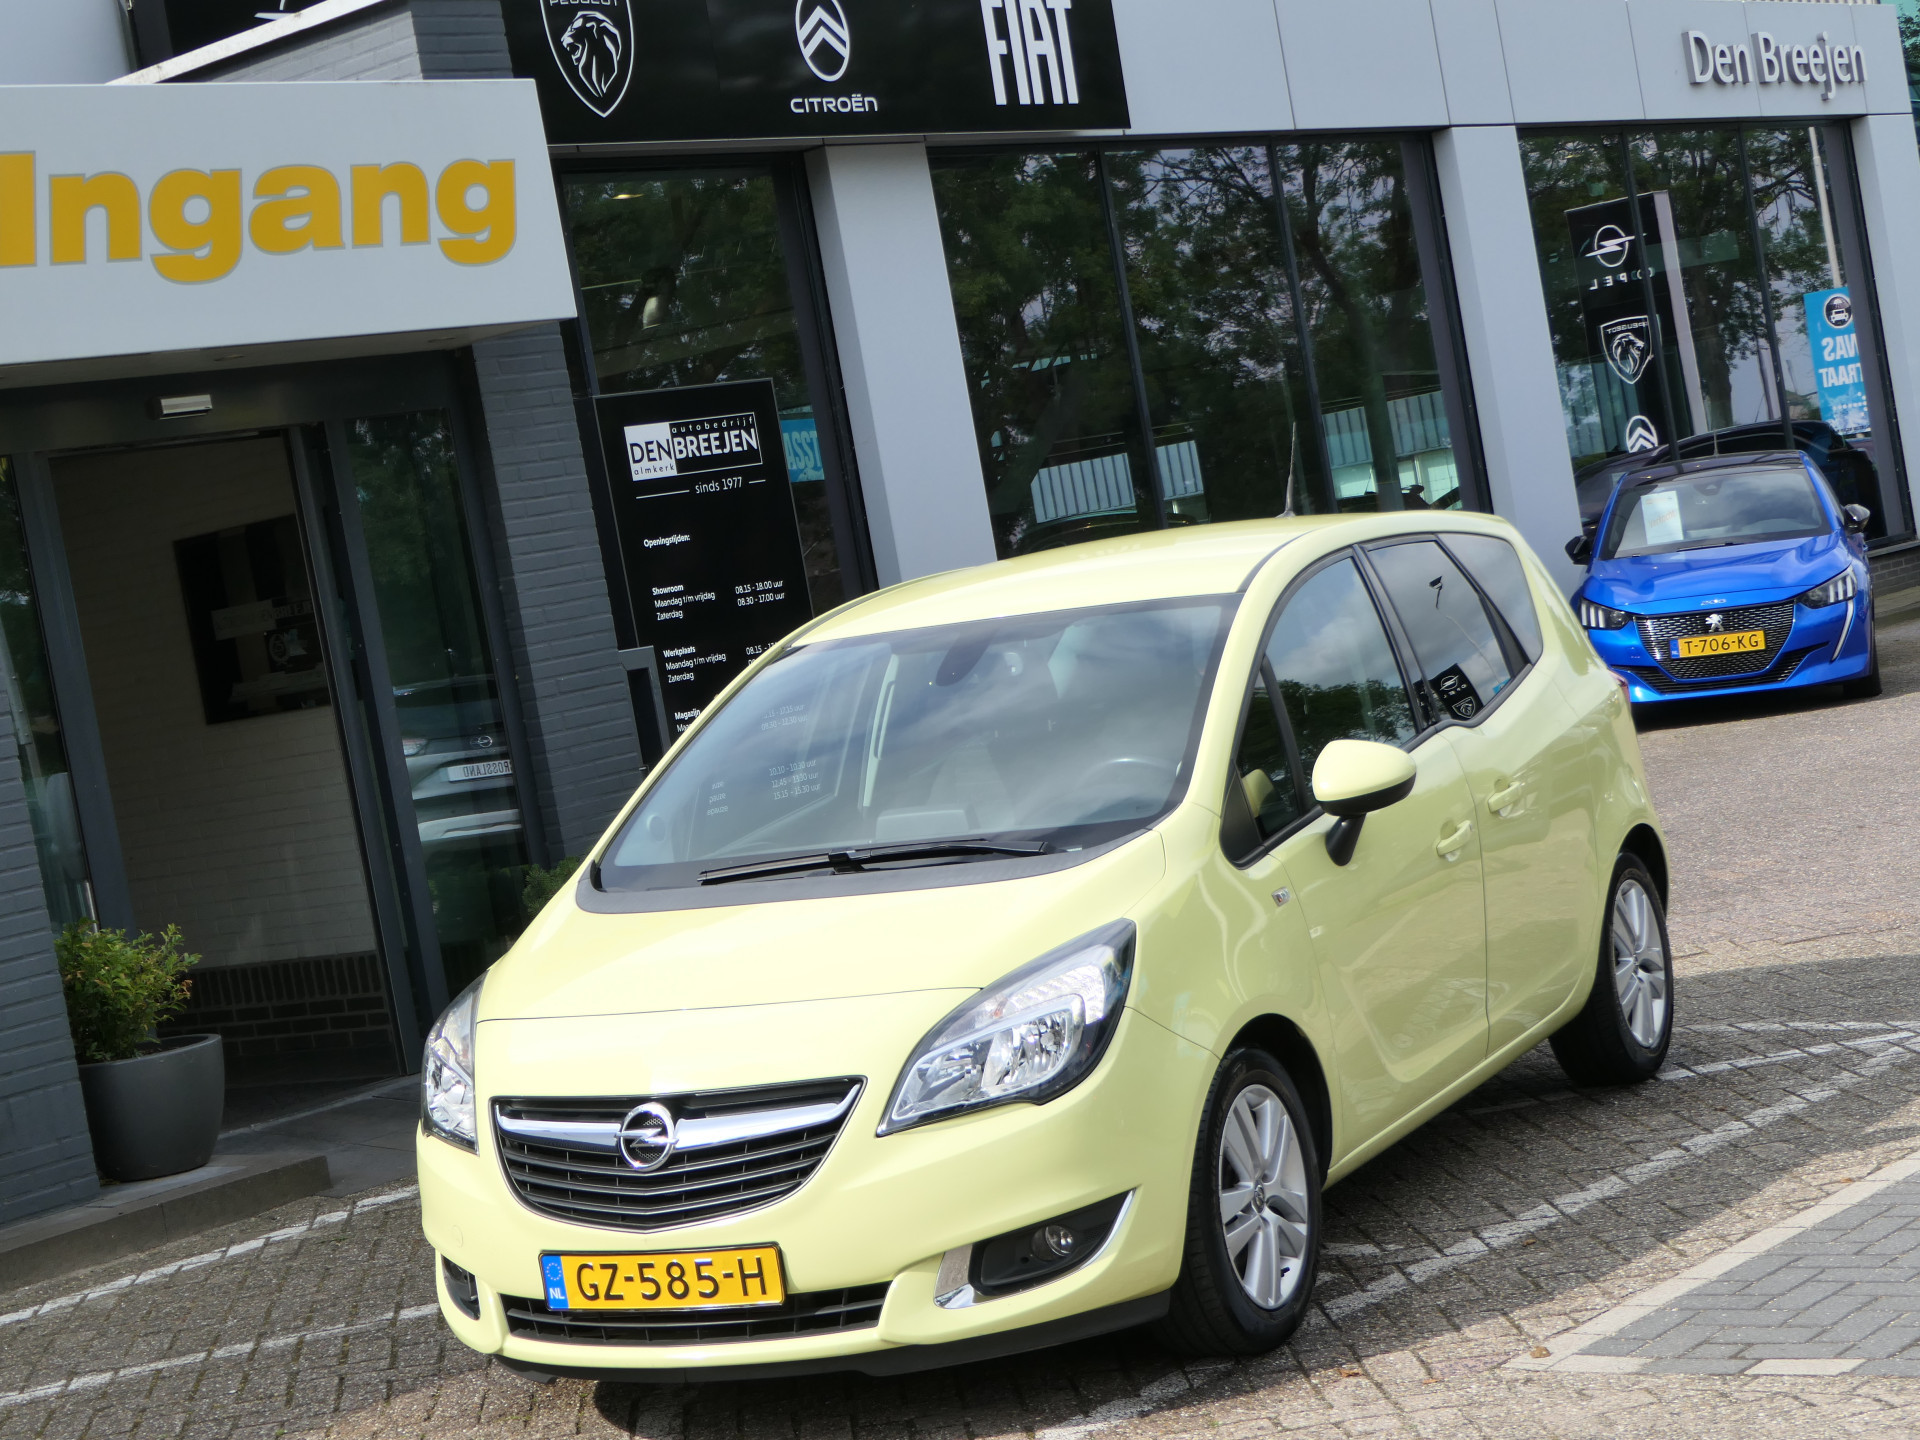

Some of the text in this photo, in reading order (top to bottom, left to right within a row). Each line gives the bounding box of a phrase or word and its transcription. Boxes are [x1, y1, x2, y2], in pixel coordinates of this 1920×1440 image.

[980, 0, 1079, 106] FIAT
[1682, 31, 1867, 101] Den Breejen
[0, 150, 517, 285] Ingang
[672, 416, 752, 434] autobedrijf
[634, 463, 675, 476] almkerk
[695, 476, 742, 494] sinds 1977
[643, 534, 690, 548] Openingstijden:
[652, 584, 684, 596] Showroom
[654, 597, 683, 608] Maandag
[683, 595, 694, 603] t/m
[694, 592, 715, 602] vrijdag
[735, 584, 751, 594] 08.15
[755, 581, 772, 591] 18.00
[773, 580, 783, 588] uur
[656, 610, 683, 621] Zaterdag
[737, 596, 754, 606] 08.30
[758, 593, 774, 603] 17.00
[774, 592, 785, 600] uur
[663, 646, 696, 657] Werkplaats
[1684, 634, 1759, 654] T-706-KG
[665, 660, 694, 671] Maandag
[694, 657, 705, 666] t/m
[705, 653, 726, 664] vrijdag
[745, 645, 762, 655] 08.15
[668, 672, 694, 683] Zaterdag
[674, 708, 700, 720] Magazijn
[806, 759, 816, 768] uur
[810, 783, 820, 792] uur
[549, 1256, 768, 1301] NL GZ-585-H
